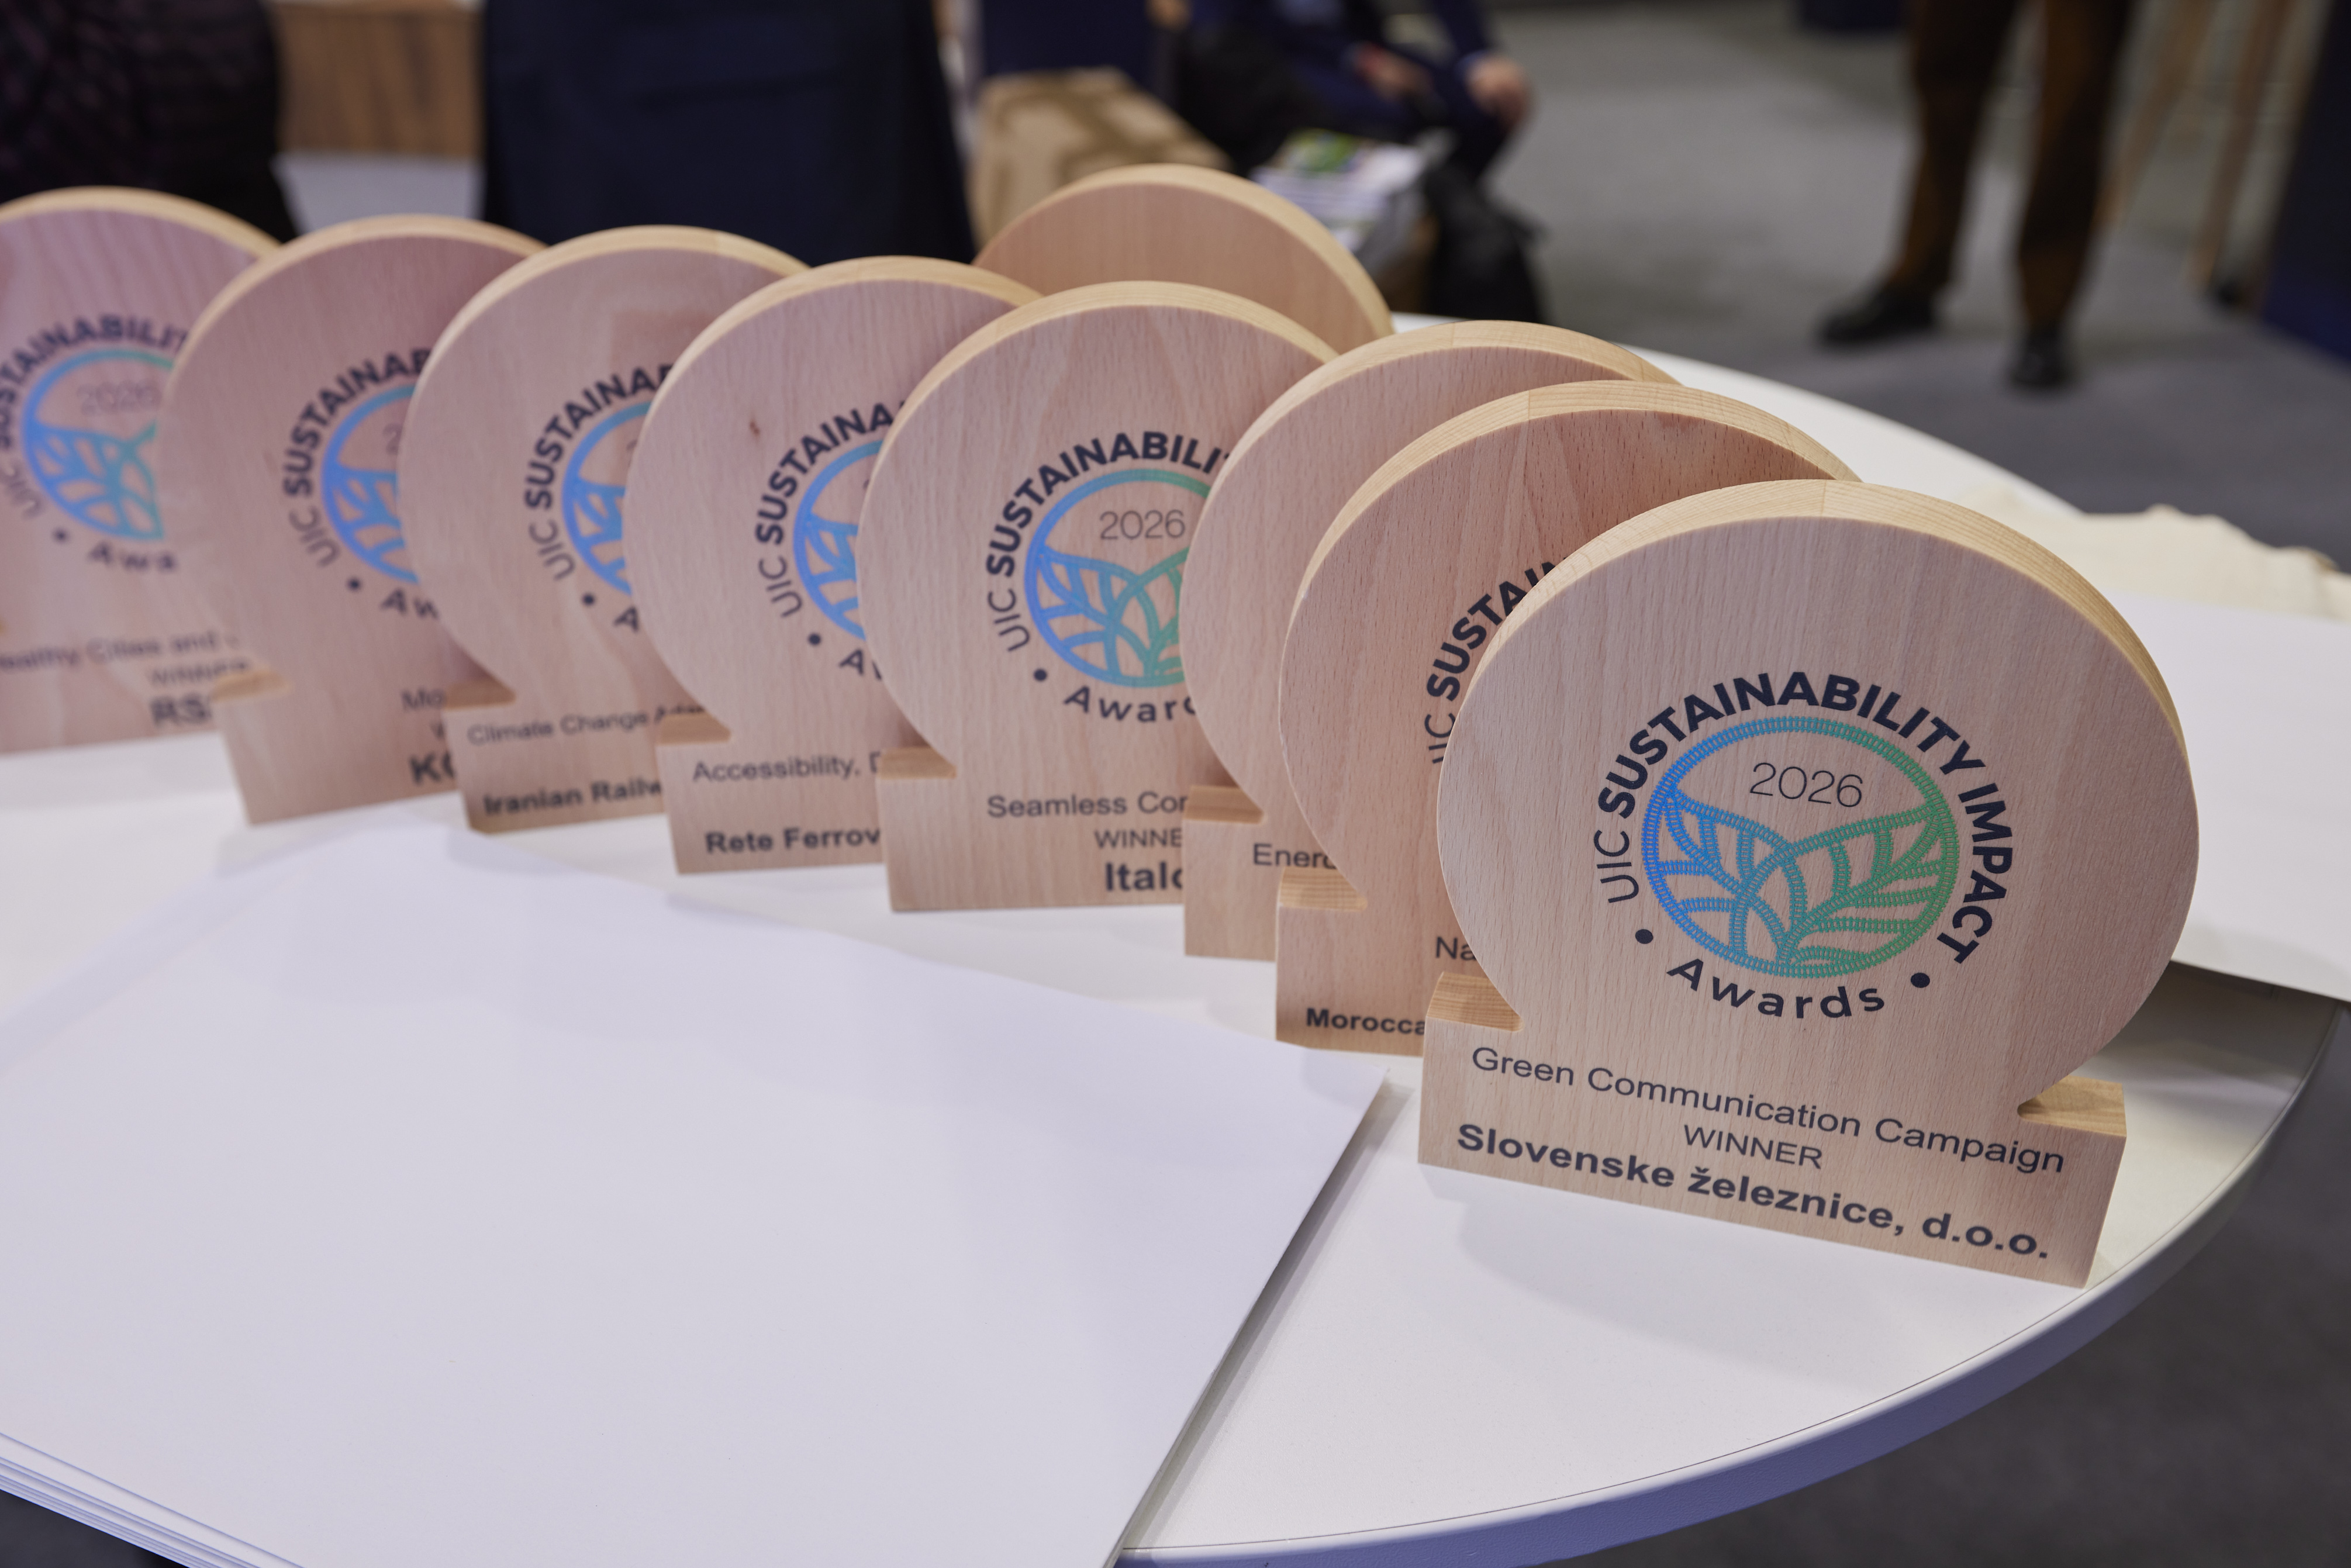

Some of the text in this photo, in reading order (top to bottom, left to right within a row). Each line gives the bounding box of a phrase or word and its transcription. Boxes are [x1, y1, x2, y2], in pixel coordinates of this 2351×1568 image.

[288, 506, 340, 567] UIC
[755, 401, 906, 617] UIC SUSTAINA
[1100, 509, 1186, 540] 2026
[529, 520, 576, 581] UIC
[986, 431, 1230, 652] UIC SUSTAINABILI
[1426, 557, 1568, 702] SUSTAI
[838, 648, 882, 681] A
[468, 721, 554, 746] Climate
[560, 710, 650, 735] Change
[484, 787, 583, 815] Iranian
[987, 794, 1128, 818] Seamless
[1749, 762, 1863, 808] 2026
[705, 830, 774, 854] Rete
[1593, 671, 2013, 965] UIC SUSTAINABILITY IMPACT
[1666, 958, 1885, 1019] Awards
[1472, 1047, 2065, 1173] Green Communication Campaign
[1683, 1124, 1823, 1169] WINNER
[1457, 1123, 2048, 1259] Slovenske železnice, d.o.o.
